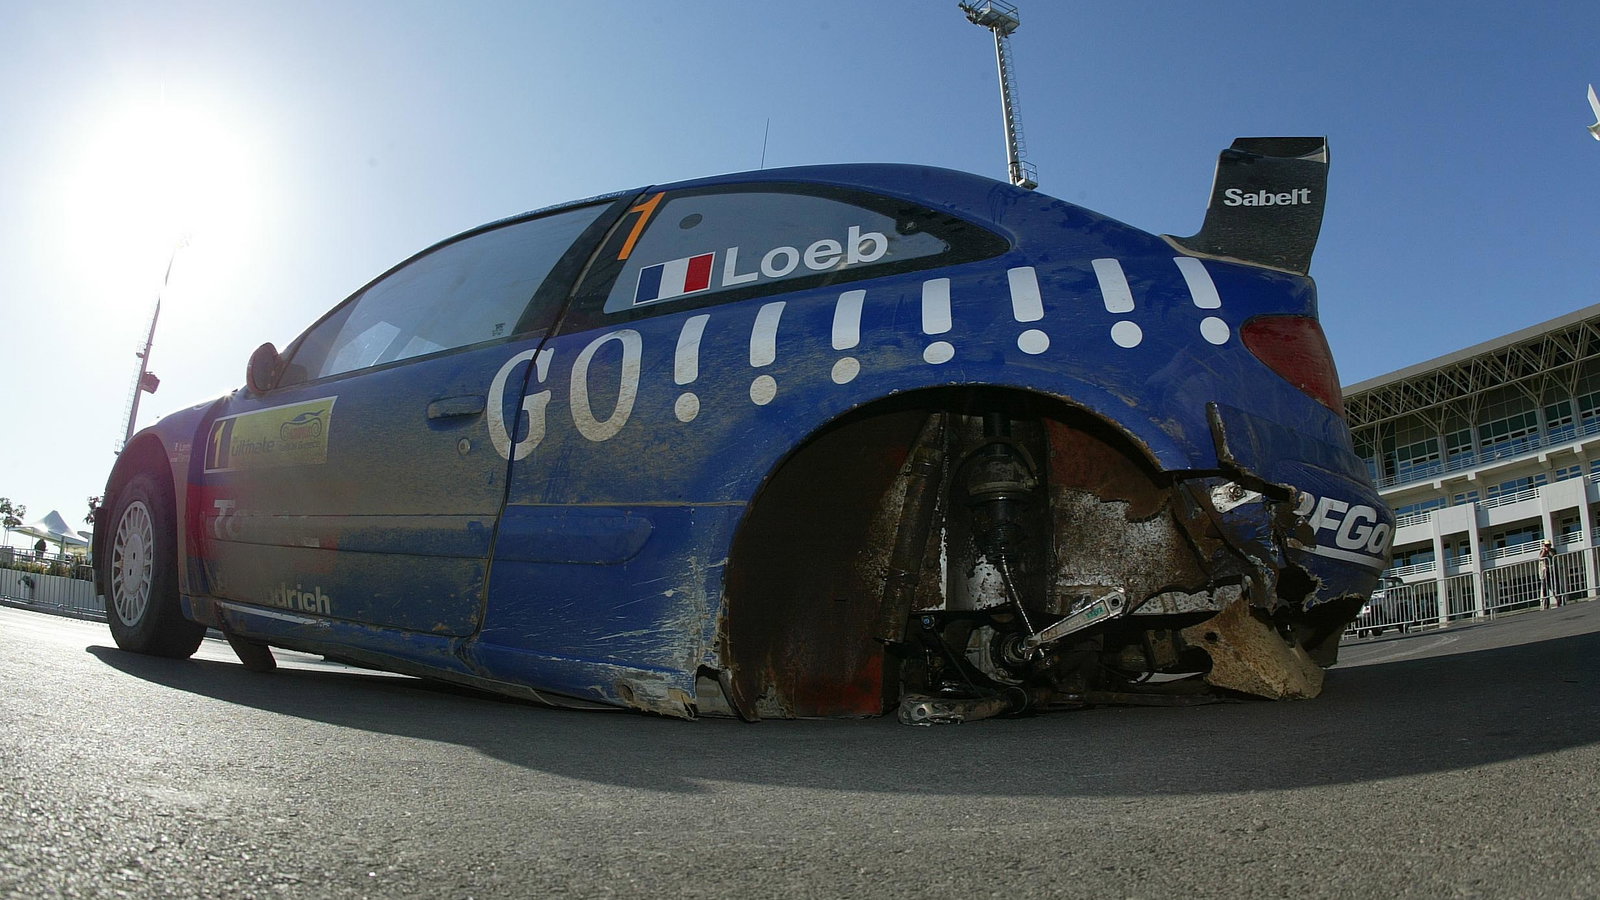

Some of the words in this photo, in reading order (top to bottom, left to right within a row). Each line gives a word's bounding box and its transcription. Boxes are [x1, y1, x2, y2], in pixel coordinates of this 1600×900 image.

[617, 192, 665, 261] 1
[1223, 187, 1311, 206] Sabelt
[721, 225, 888, 287] Loeb
